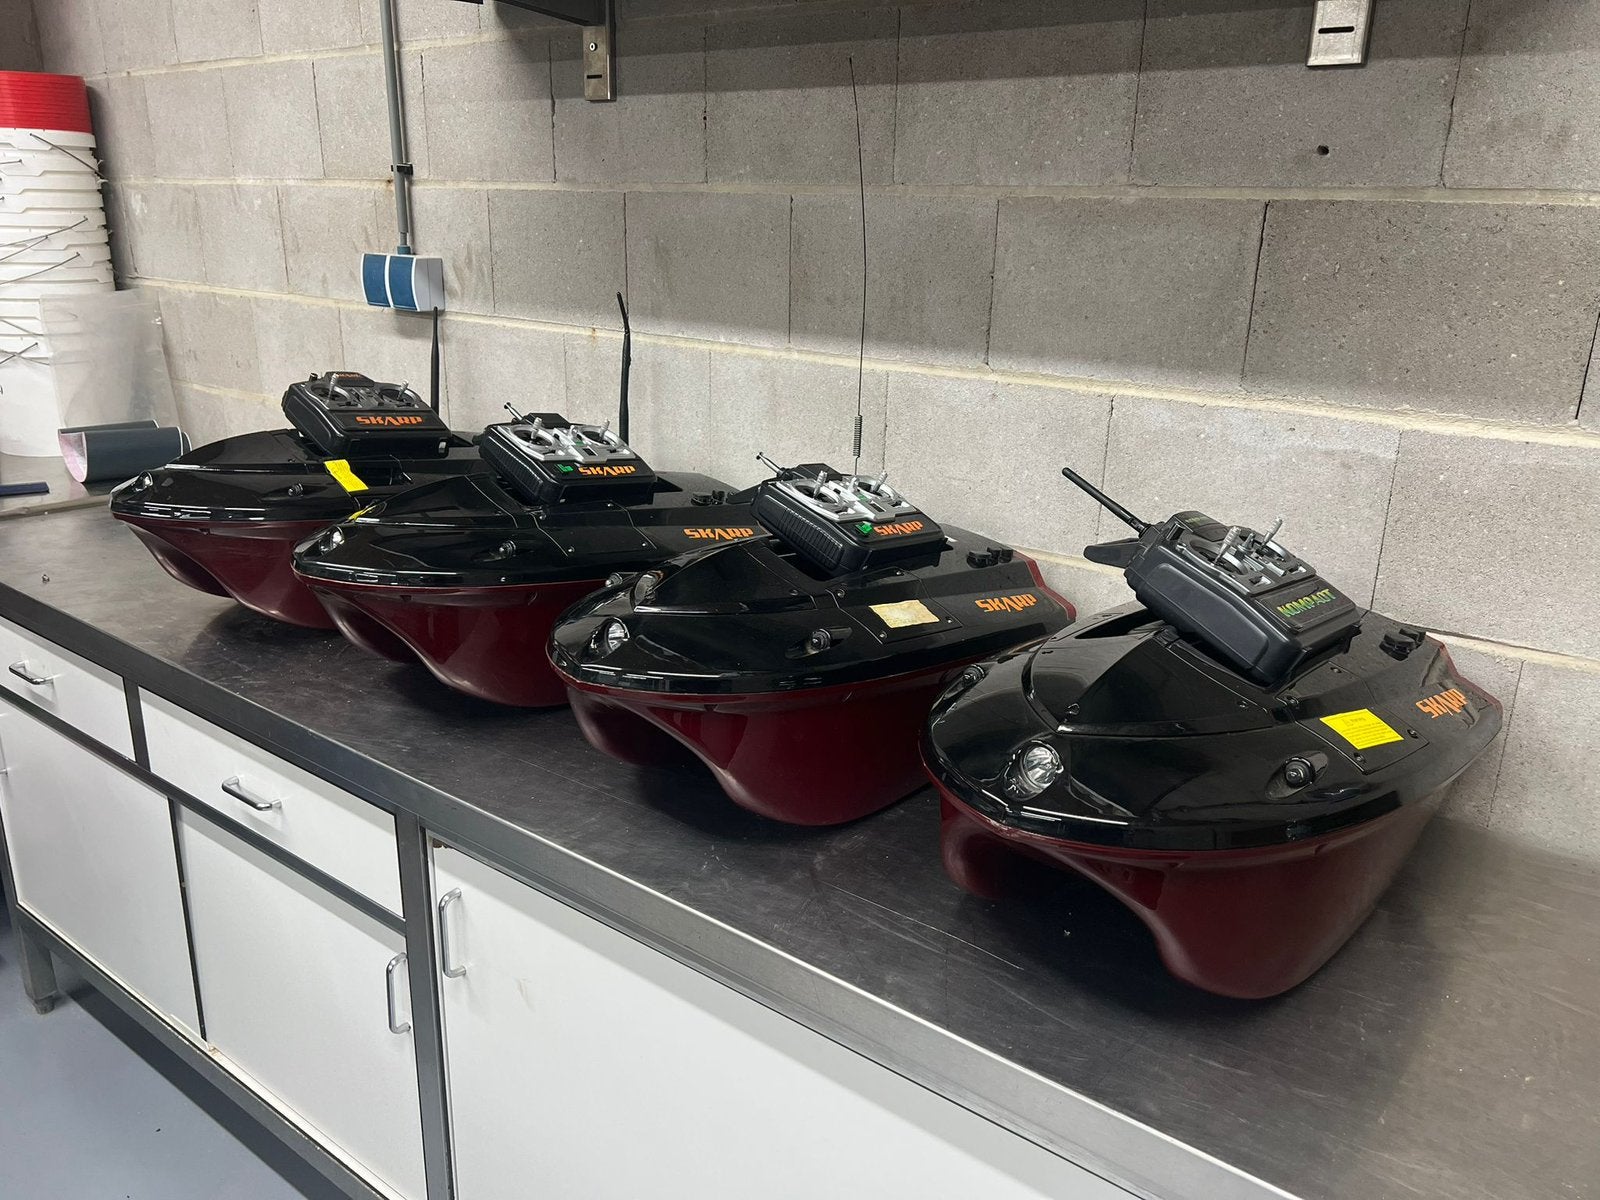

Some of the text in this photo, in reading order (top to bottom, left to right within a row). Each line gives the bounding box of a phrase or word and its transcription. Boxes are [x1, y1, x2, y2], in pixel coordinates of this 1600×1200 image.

[355, 416, 423, 426] SKARP
[578, 465, 636, 476] SKARP
[683, 528, 754, 540] SKARP
[873, 520, 924, 536] SKARP
[974, 593, 1038, 613] SKARP
[1415, 688, 1468, 718] SKARP
